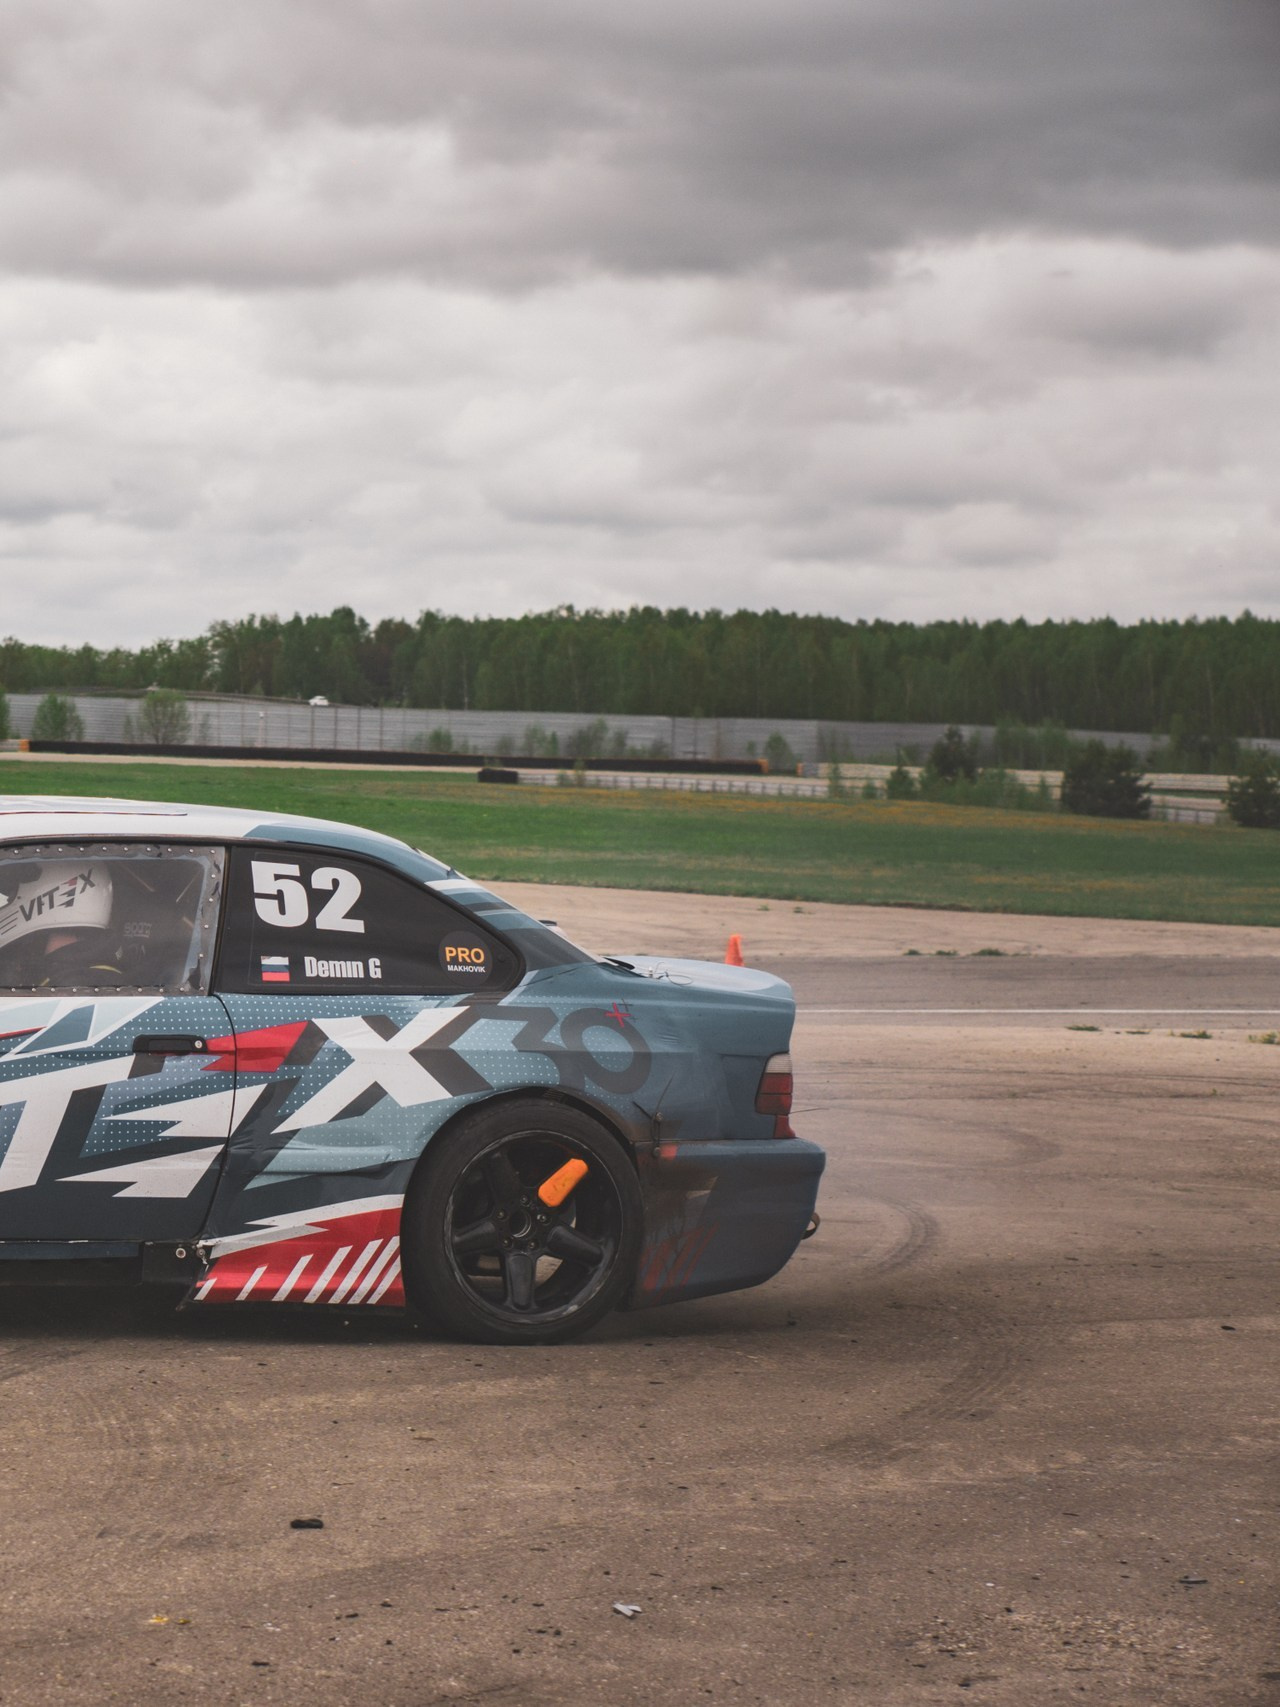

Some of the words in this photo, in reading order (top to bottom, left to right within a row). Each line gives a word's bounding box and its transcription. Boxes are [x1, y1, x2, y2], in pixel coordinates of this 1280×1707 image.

[251, 860, 365, 933] 52
[445, 946, 485, 963] PRO
[304, 956, 365, 978] Demin
[368, 957, 382, 979] G
[447, 964, 486, 973] MAKHOVIK
